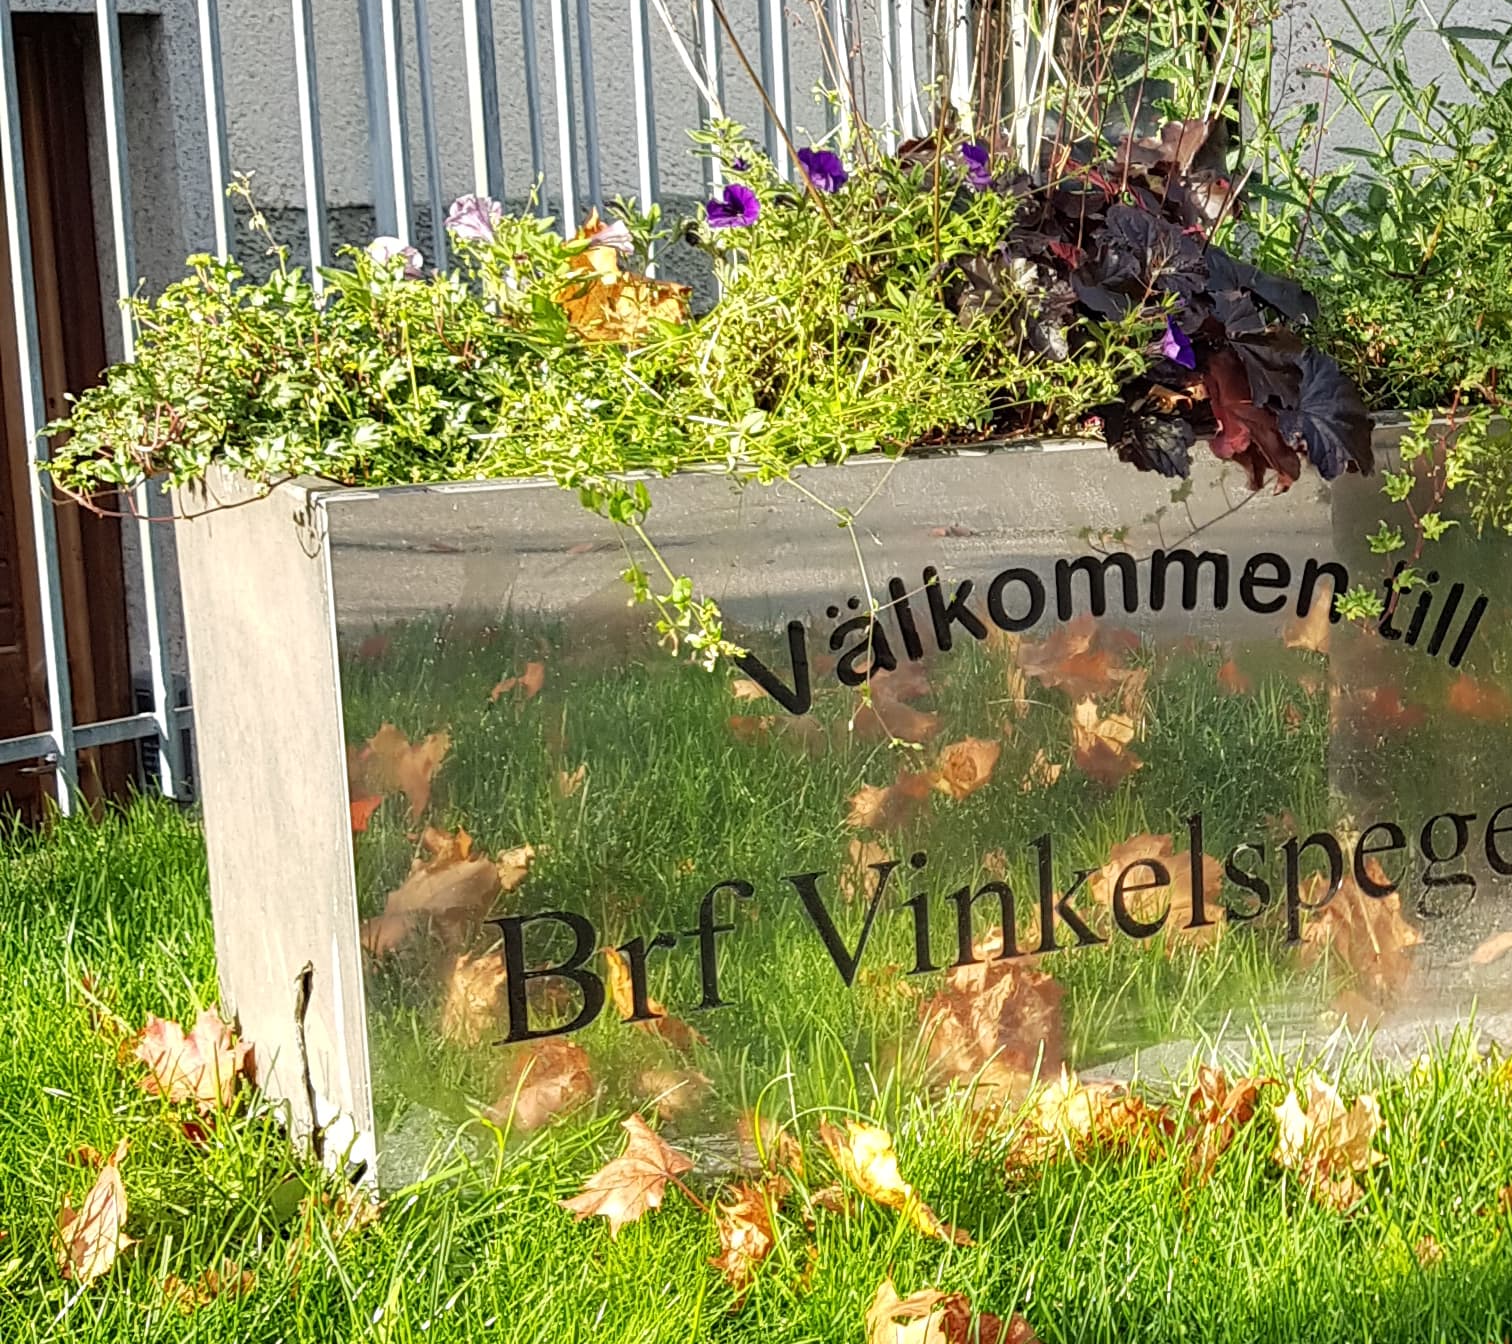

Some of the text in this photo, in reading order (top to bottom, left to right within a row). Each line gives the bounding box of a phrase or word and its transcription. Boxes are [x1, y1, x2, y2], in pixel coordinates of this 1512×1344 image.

[735, 547, 1489, 715] Välkommen till
[484, 879, 755, 1047] Brf
